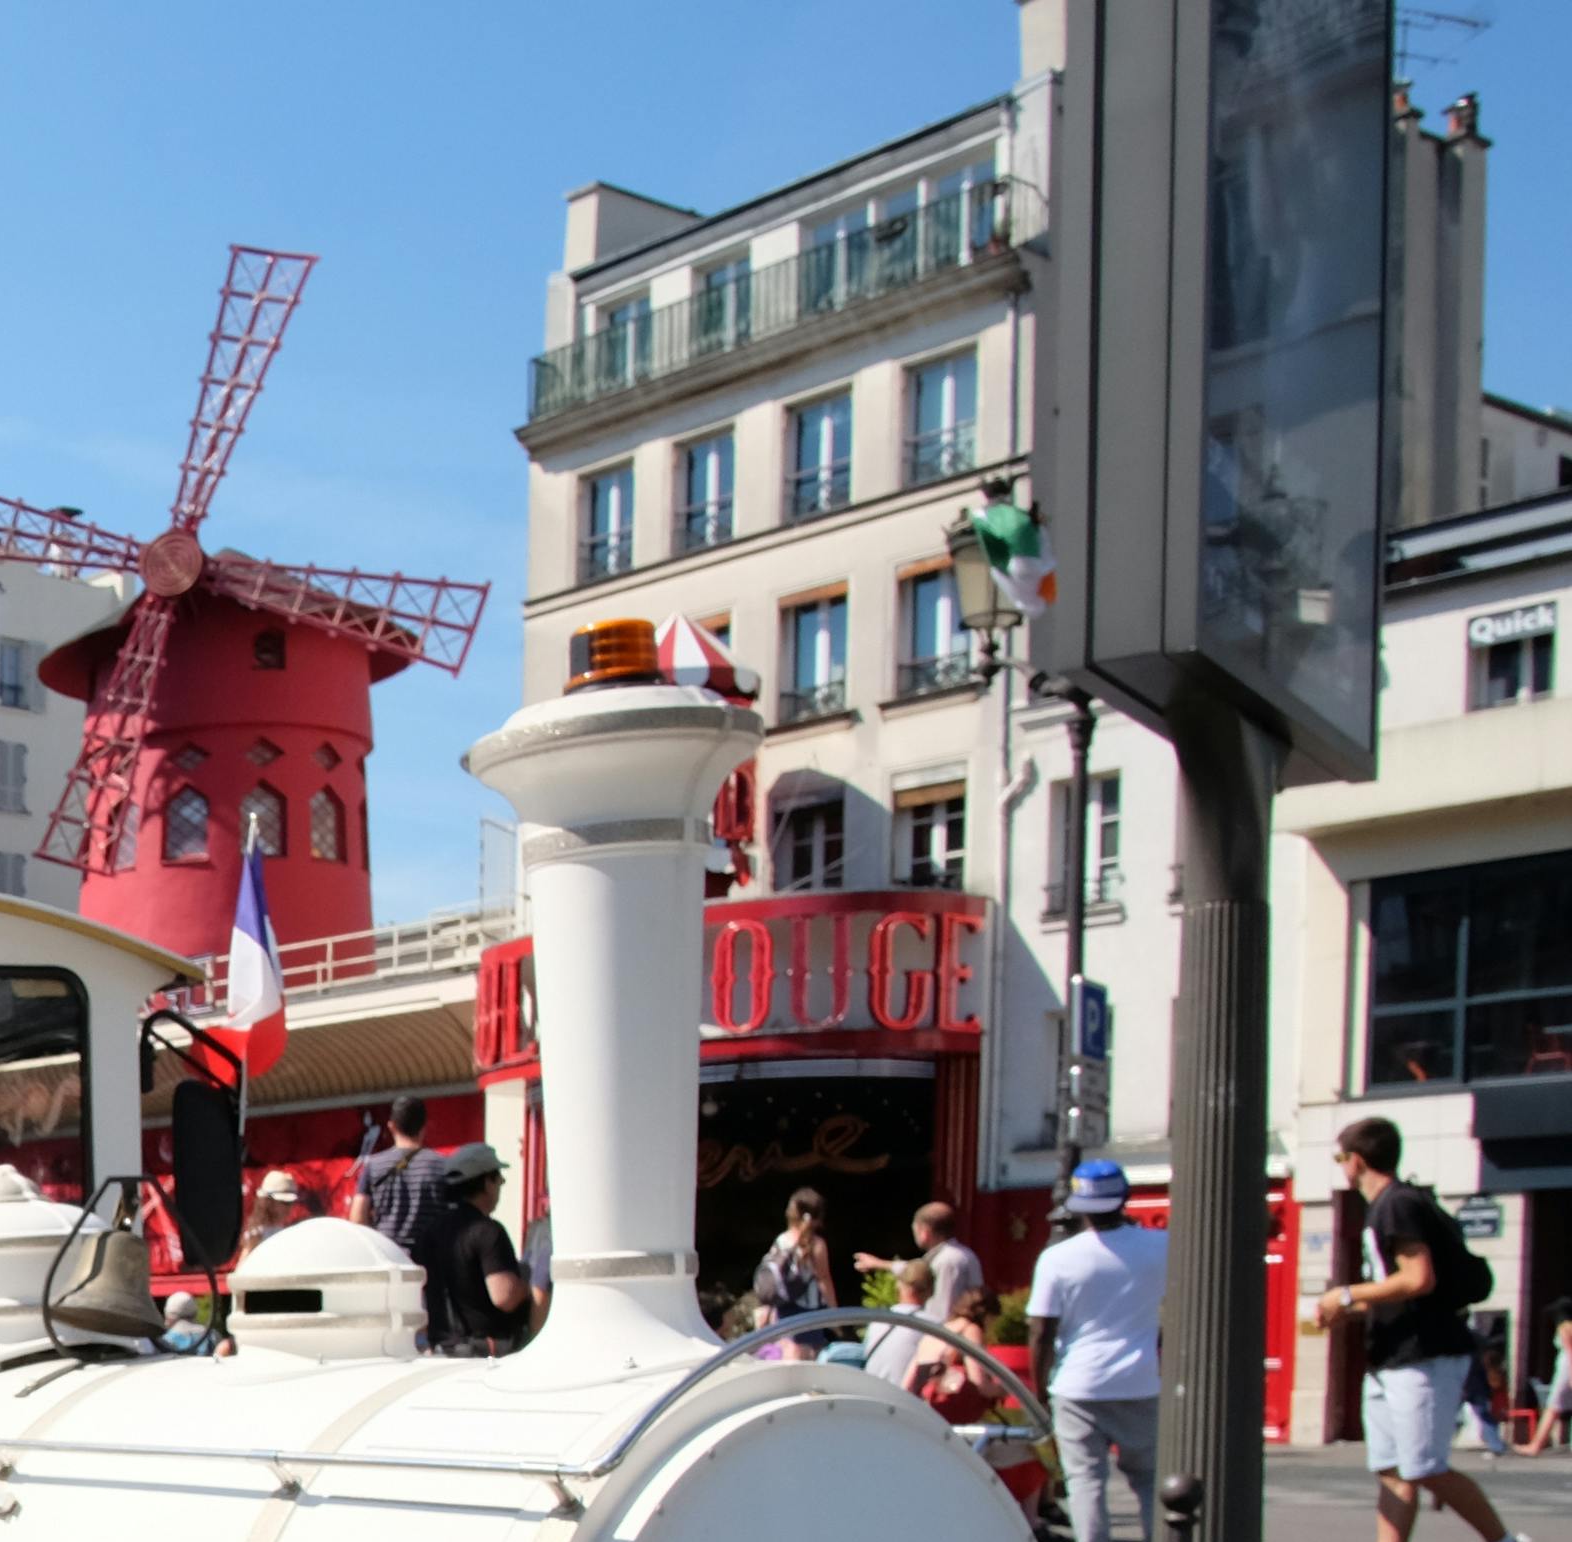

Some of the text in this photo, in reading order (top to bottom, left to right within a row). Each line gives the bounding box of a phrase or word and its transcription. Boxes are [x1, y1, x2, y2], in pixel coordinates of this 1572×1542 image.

[1470, 604, 1554, 644] Quick
[711, 911, 983, 1034] OUGE
[1086, 996, 1101, 1046] P
